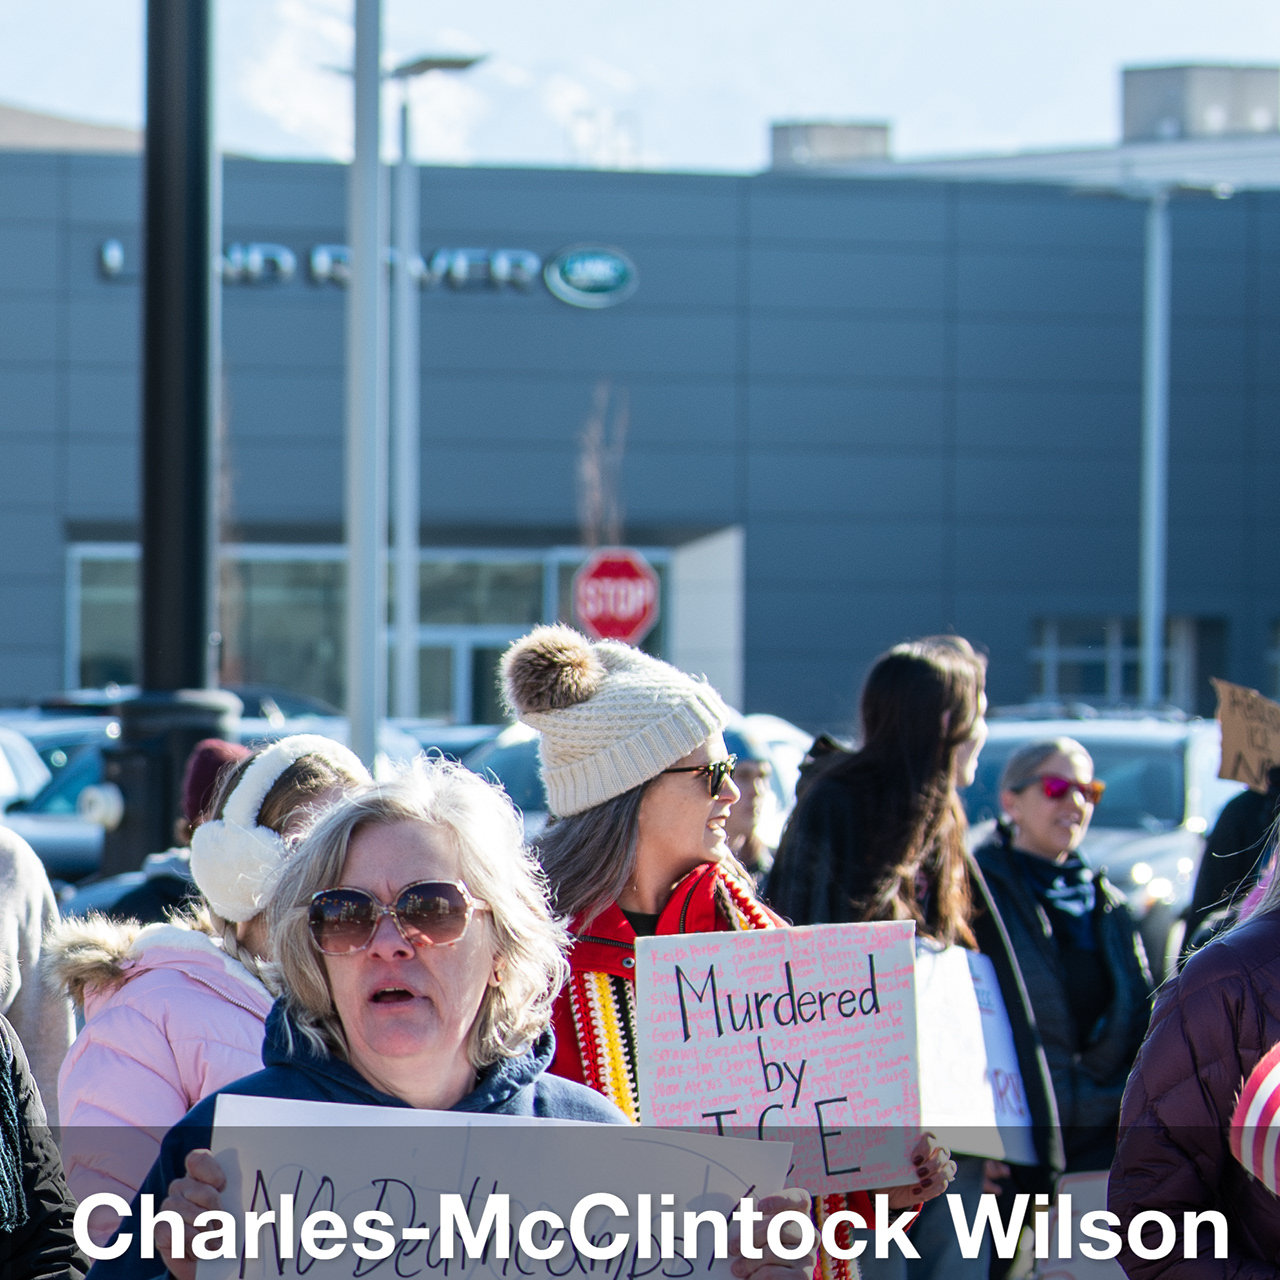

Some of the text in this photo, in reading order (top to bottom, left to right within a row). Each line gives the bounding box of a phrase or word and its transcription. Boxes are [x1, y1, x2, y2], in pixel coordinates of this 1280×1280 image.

[100, 239, 297, 284] LND
[308, 242, 543, 289] RVER
[578, 577, 655, 620] STOP
[675, 954, 881, 1042] Murdered
[757, 1036, 808, 1108] by
